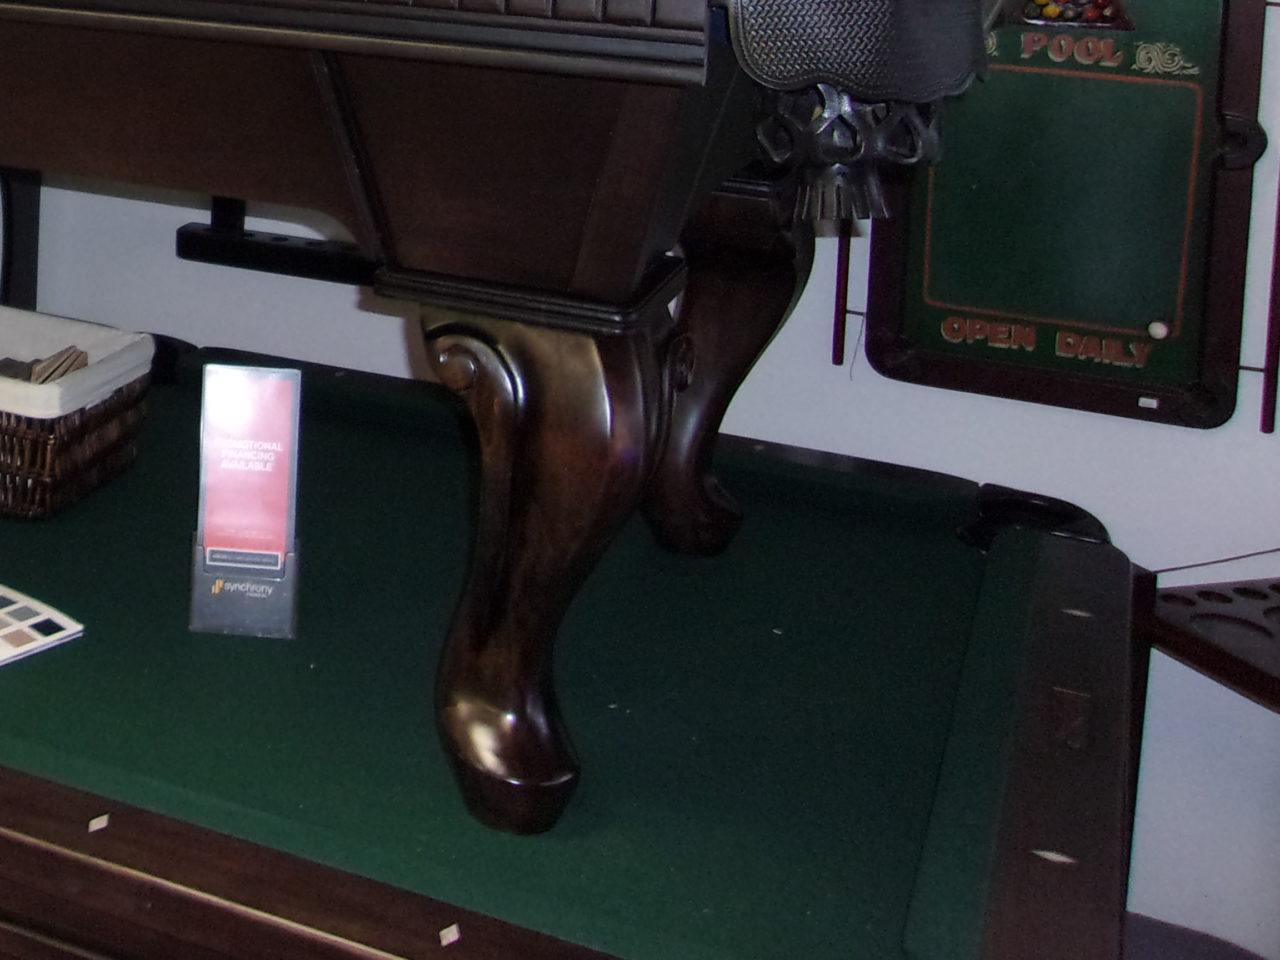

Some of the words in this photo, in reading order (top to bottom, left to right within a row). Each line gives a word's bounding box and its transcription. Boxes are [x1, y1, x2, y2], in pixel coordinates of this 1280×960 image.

[1020, 32, 1124, 68] POOL
[941, 317, 1037, 351] OPEN
[1056, 331, 1153, 368] DAILY
[221, 450, 275, 461] FINANCING
[220, 460, 273, 472] AVAILABLE
[224, 582, 273, 596] synchrony
